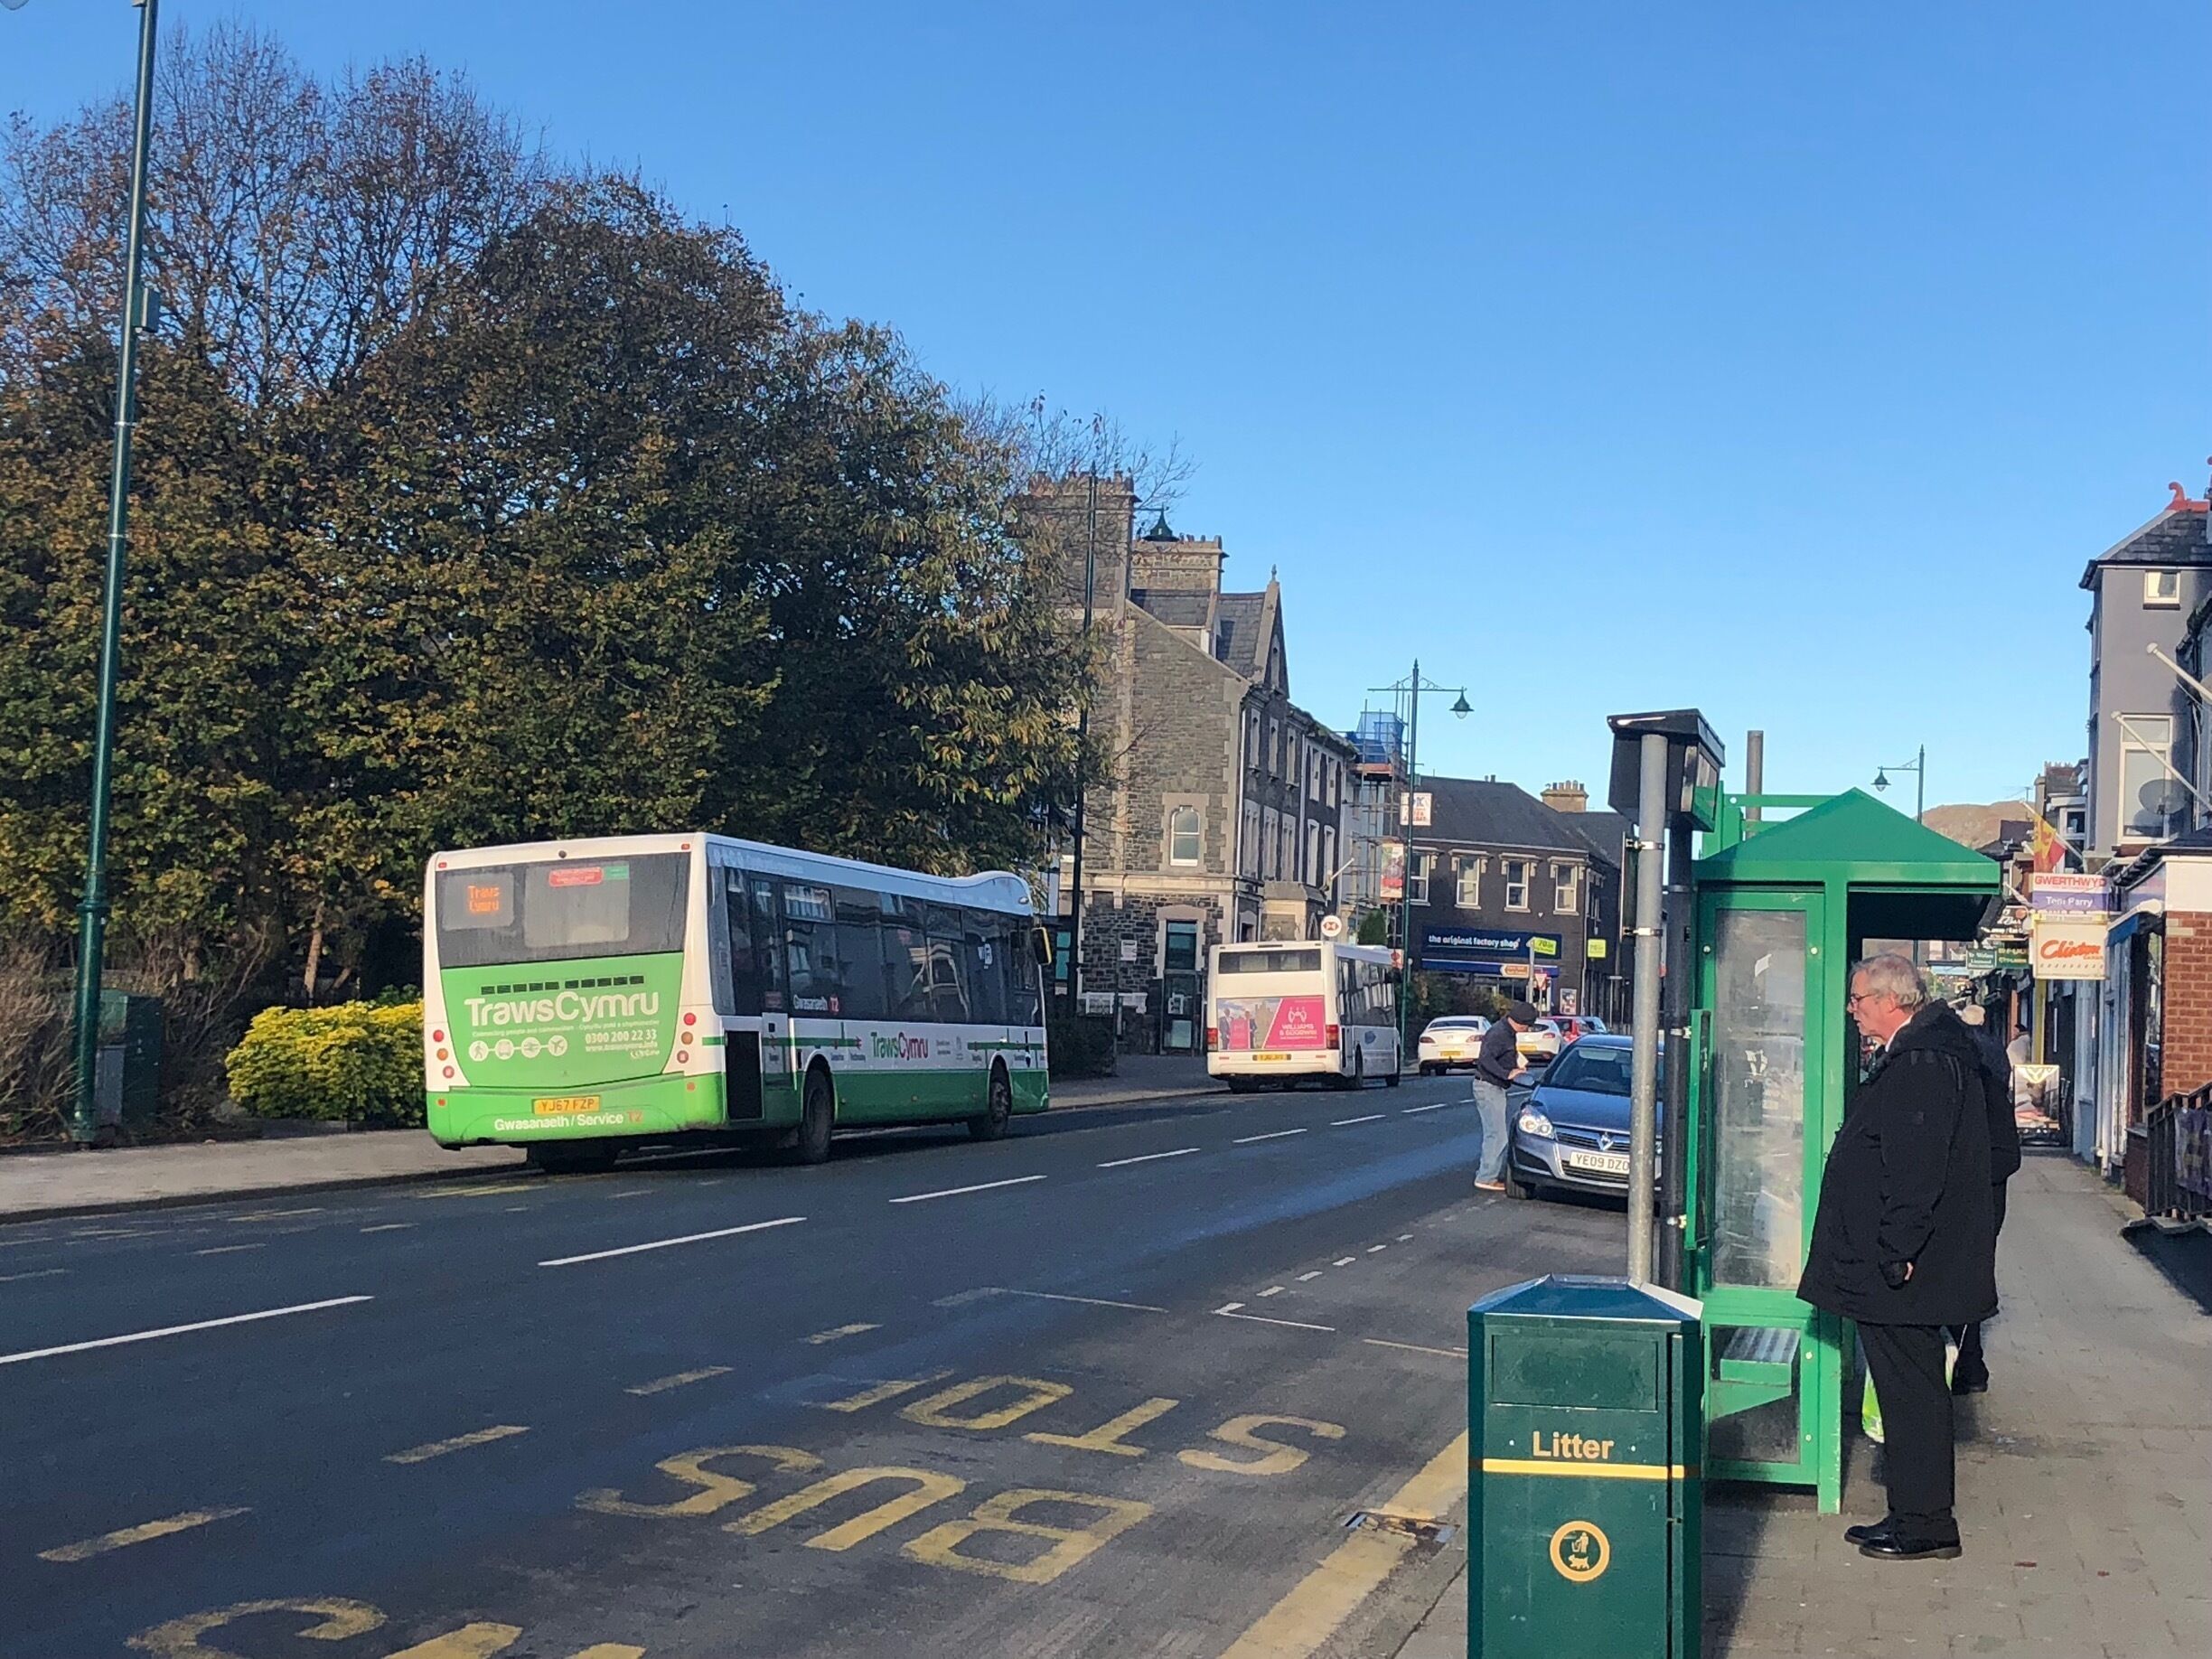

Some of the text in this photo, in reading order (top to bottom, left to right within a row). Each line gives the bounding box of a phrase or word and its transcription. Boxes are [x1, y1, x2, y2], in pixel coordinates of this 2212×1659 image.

[2035, 875, 2107, 887] GWERTHWYD
[467, 885, 500, 899] Traws
[469, 900, 500, 913] Cymru
[2067, 897, 2094, 908] Parry
[1428, 934, 1519, 950] the original factory shop
[2040, 939, 2102, 960] Clinton
[464, 990, 660, 1027] TrawsCymru
[585, 1027, 658, 1045] 0300 200 22 33
[870, 1031, 929, 1061] TrawsCymru
[540, 1098, 595, 1112] YJ67 FZP
[494, 1113, 570, 1130] Gwasanaeth
[576, 1112, 624, 1128] Service
[1576, 1154, 1605, 1168] YE09
[1532, 1430, 1615, 1459] Litter
[574, 1444, 1156, 1585] BUS
